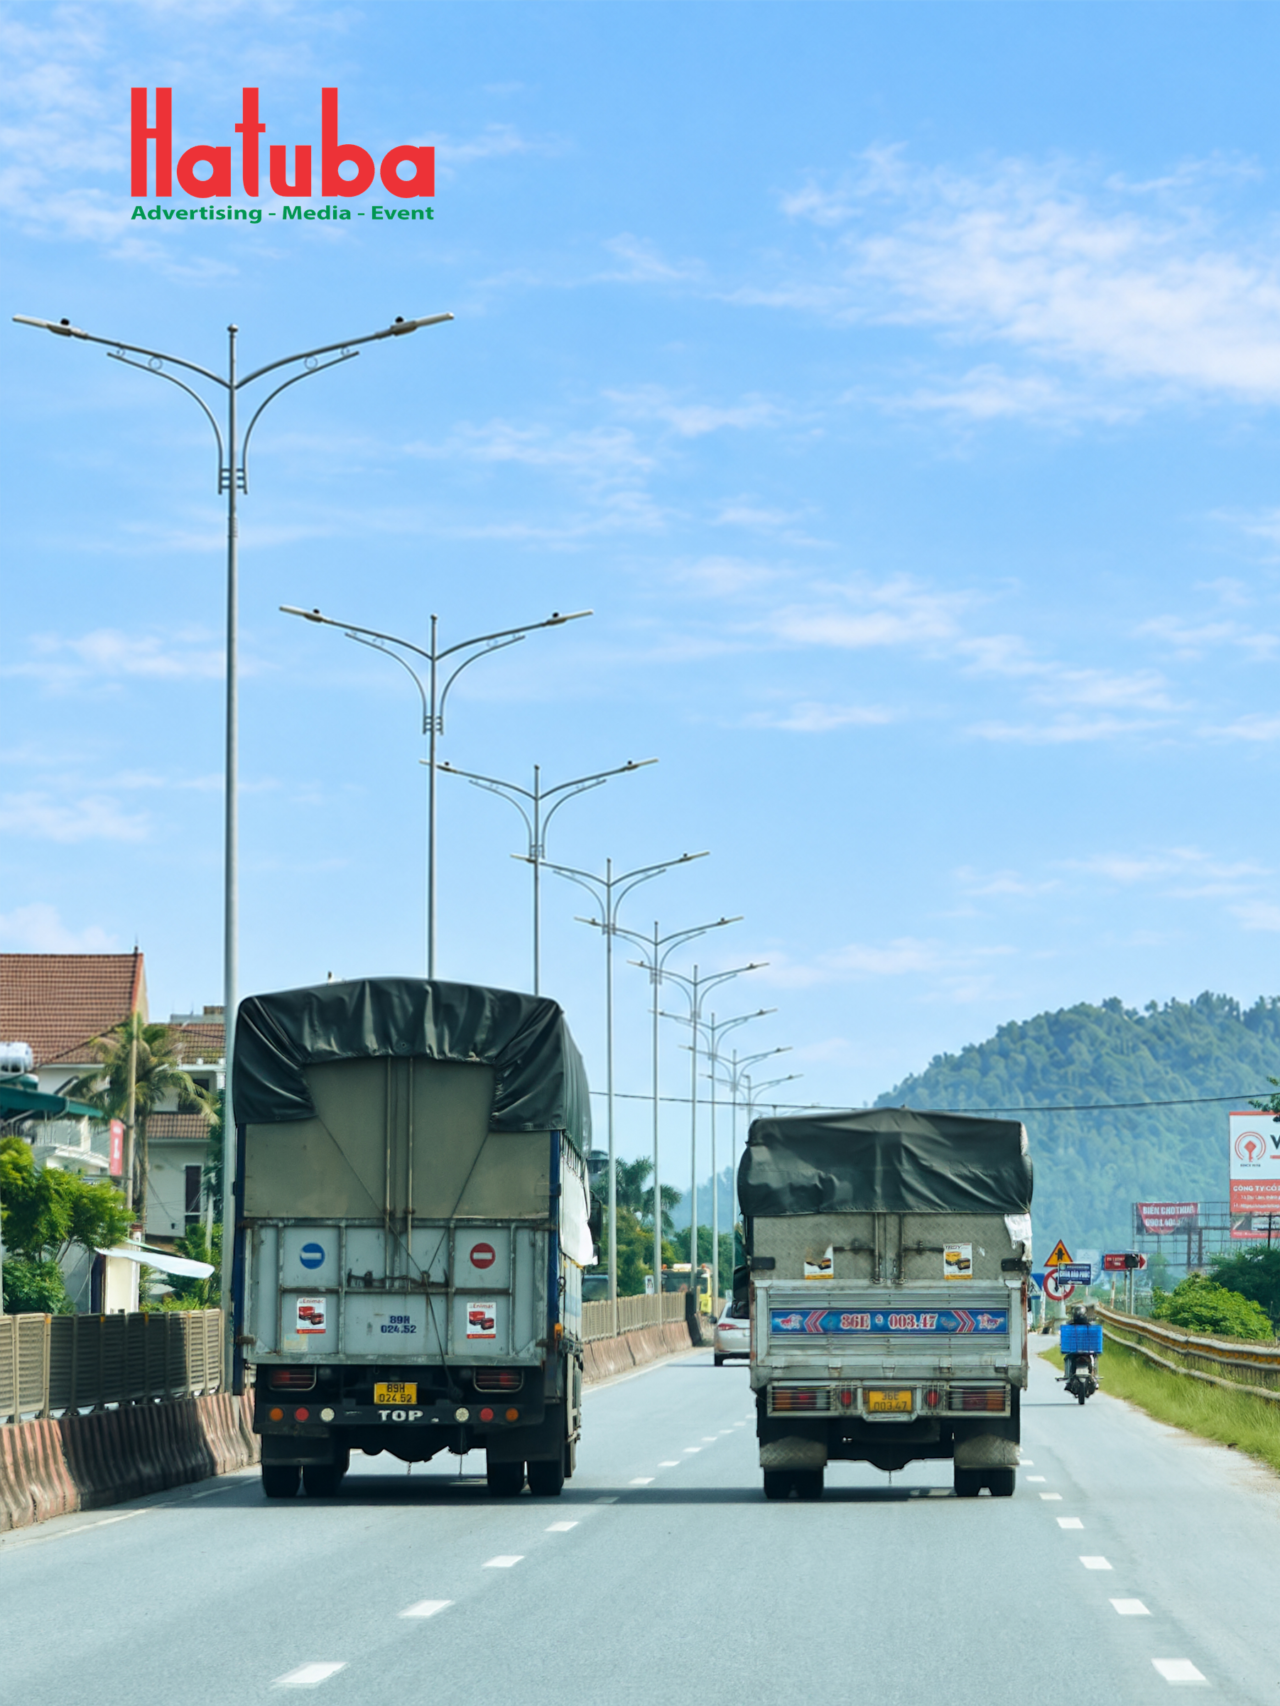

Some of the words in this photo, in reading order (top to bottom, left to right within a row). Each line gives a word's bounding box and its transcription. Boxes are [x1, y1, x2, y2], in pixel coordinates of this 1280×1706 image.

[390, 1315, 411, 1325] 89H
[841, 1313, 871, 1330] 36E
[888, 1313, 938, 1330] 003.47
[380, 1325, 417, 1334] 024.52
[386, 1383, 406, 1393] 89H
[379, 1394, 413, 1403] 024.52
[873, 1401, 908, 1411] 003.47
[378, 1409, 424, 1422] TOP
